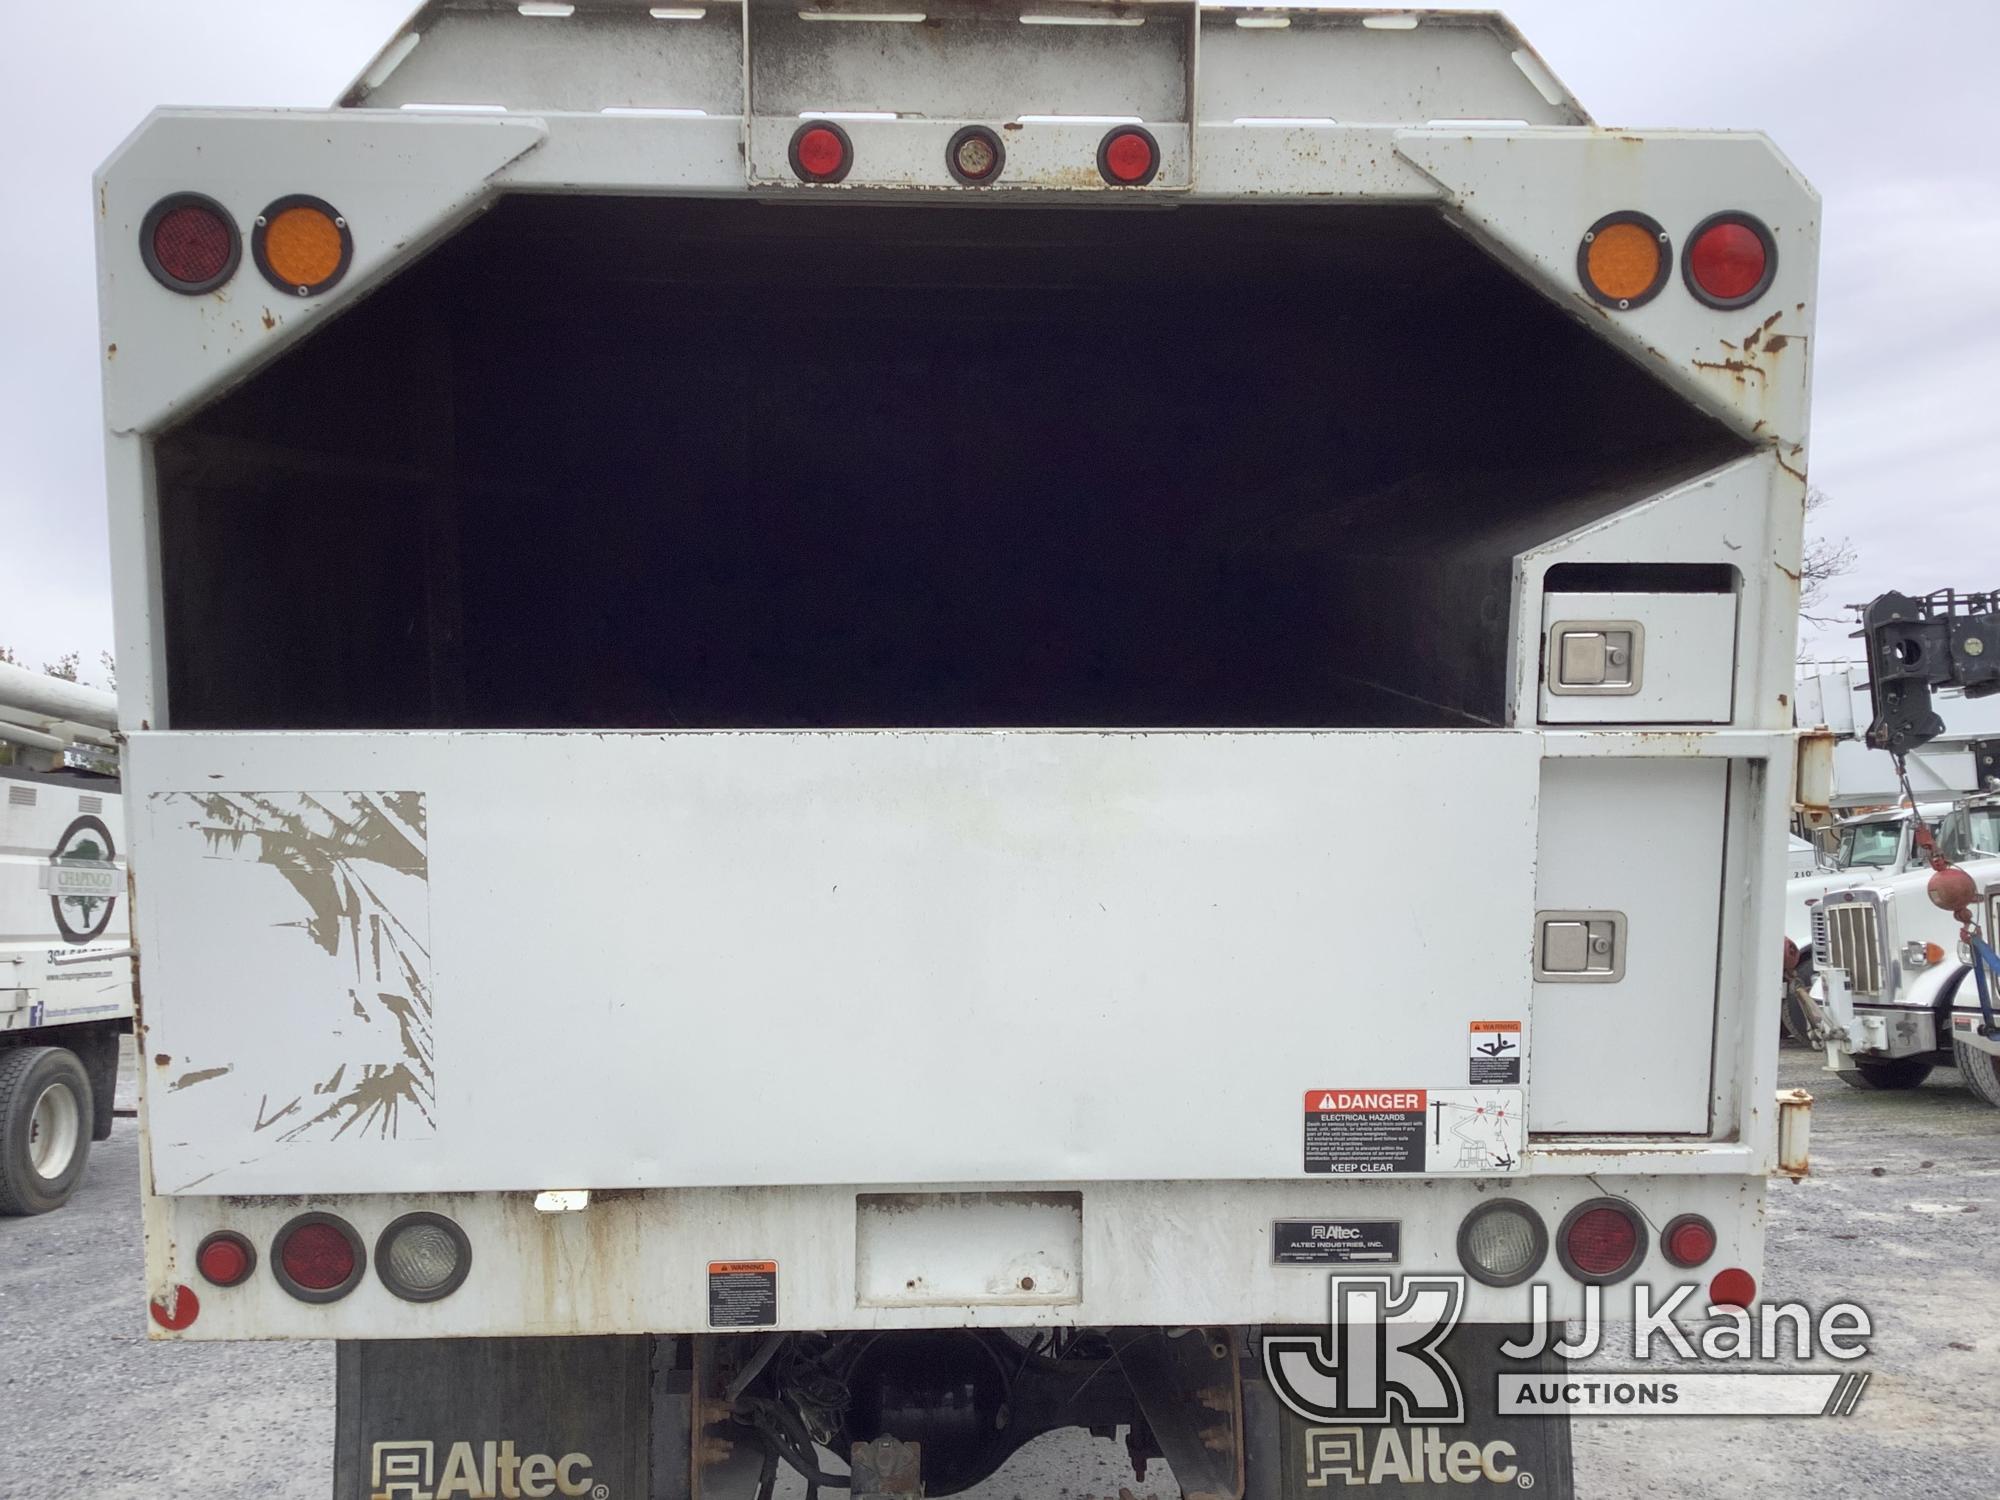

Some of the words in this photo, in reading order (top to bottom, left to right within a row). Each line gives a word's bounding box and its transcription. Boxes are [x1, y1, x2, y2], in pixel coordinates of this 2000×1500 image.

[1338, 1094, 1418, 1109] DANGER
[1331, 1164, 1358, 1172] KEEP
[1360, 1164, 1394, 1172] CLEAR
[1326, 1226, 1360, 1240] Altec
